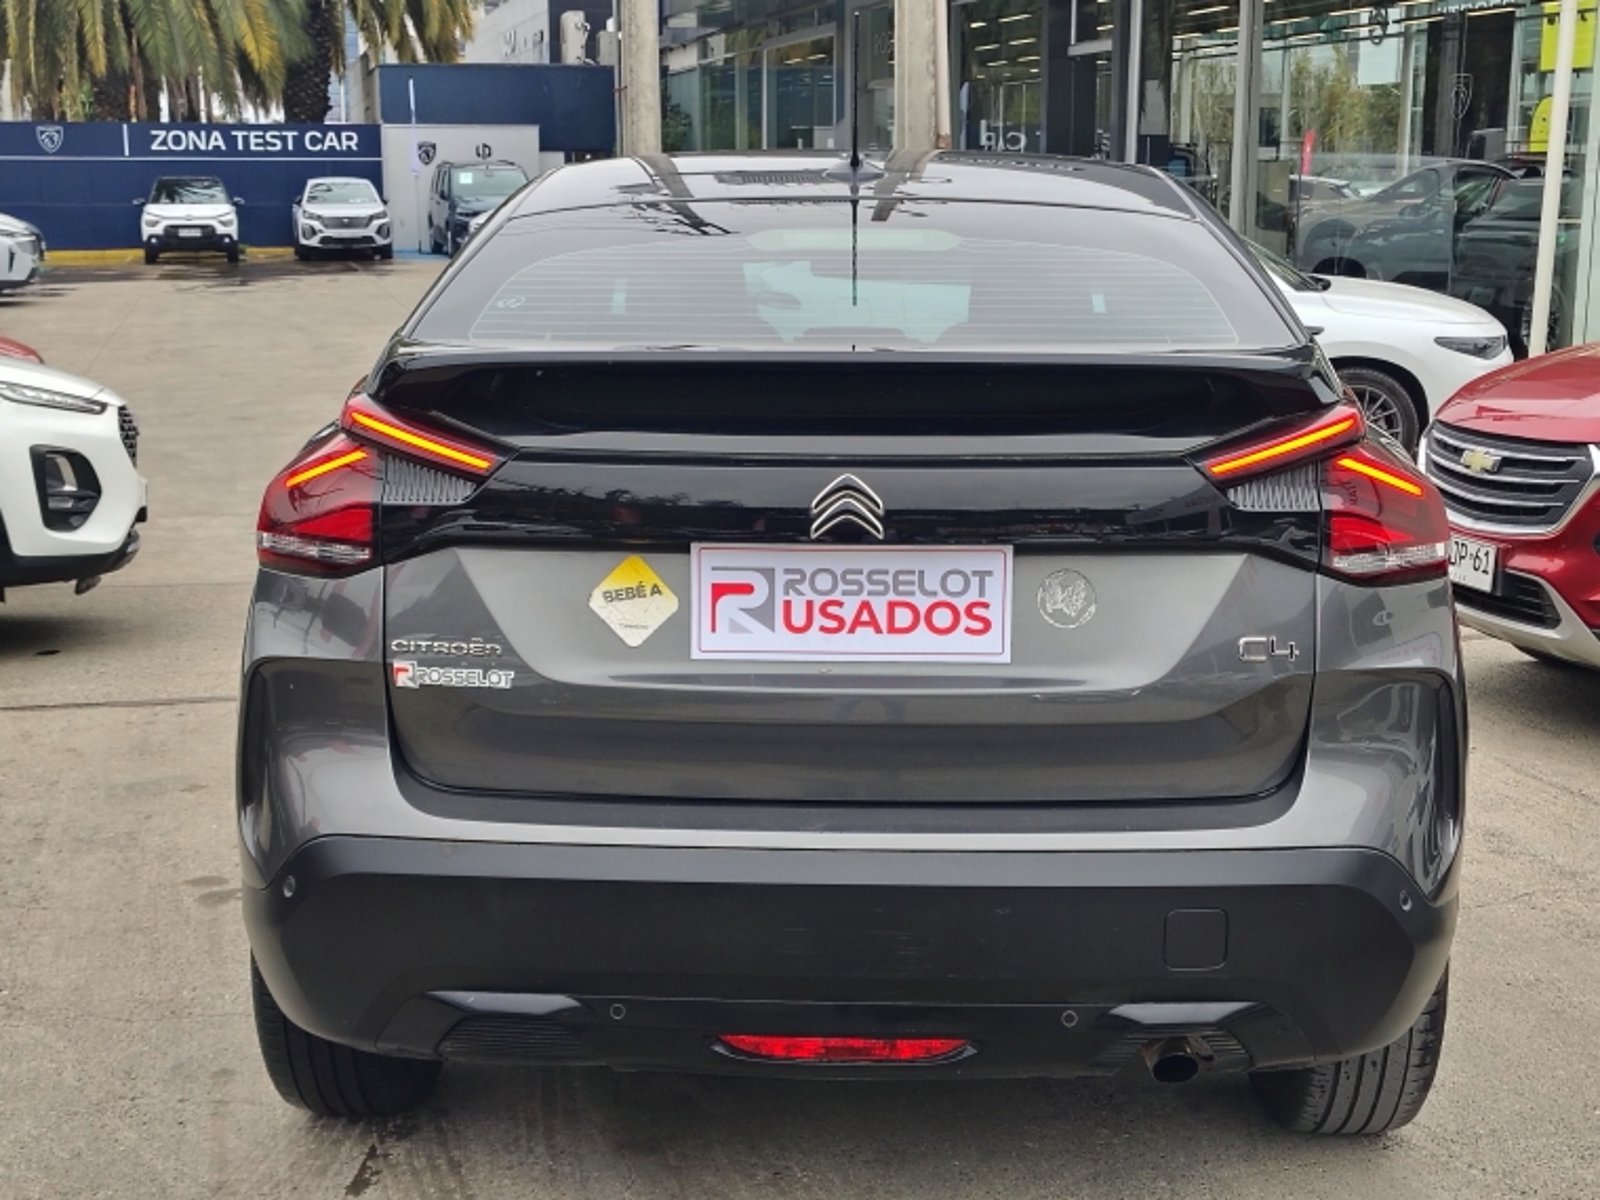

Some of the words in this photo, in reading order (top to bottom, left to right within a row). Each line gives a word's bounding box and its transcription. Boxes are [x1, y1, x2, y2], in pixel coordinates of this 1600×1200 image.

[150, 130, 226, 150] ZONA
[231, 131, 298, 150] TEST
[304, 131, 359, 150] CAR
[650, 583, 662, 597] A
[783, 567, 994, 597] ROSSELOT
[783, 599, 993, 636] USADOS
[1239, 636, 1300, 661] C4
[416, 667, 515, 688] ROSSELOT
